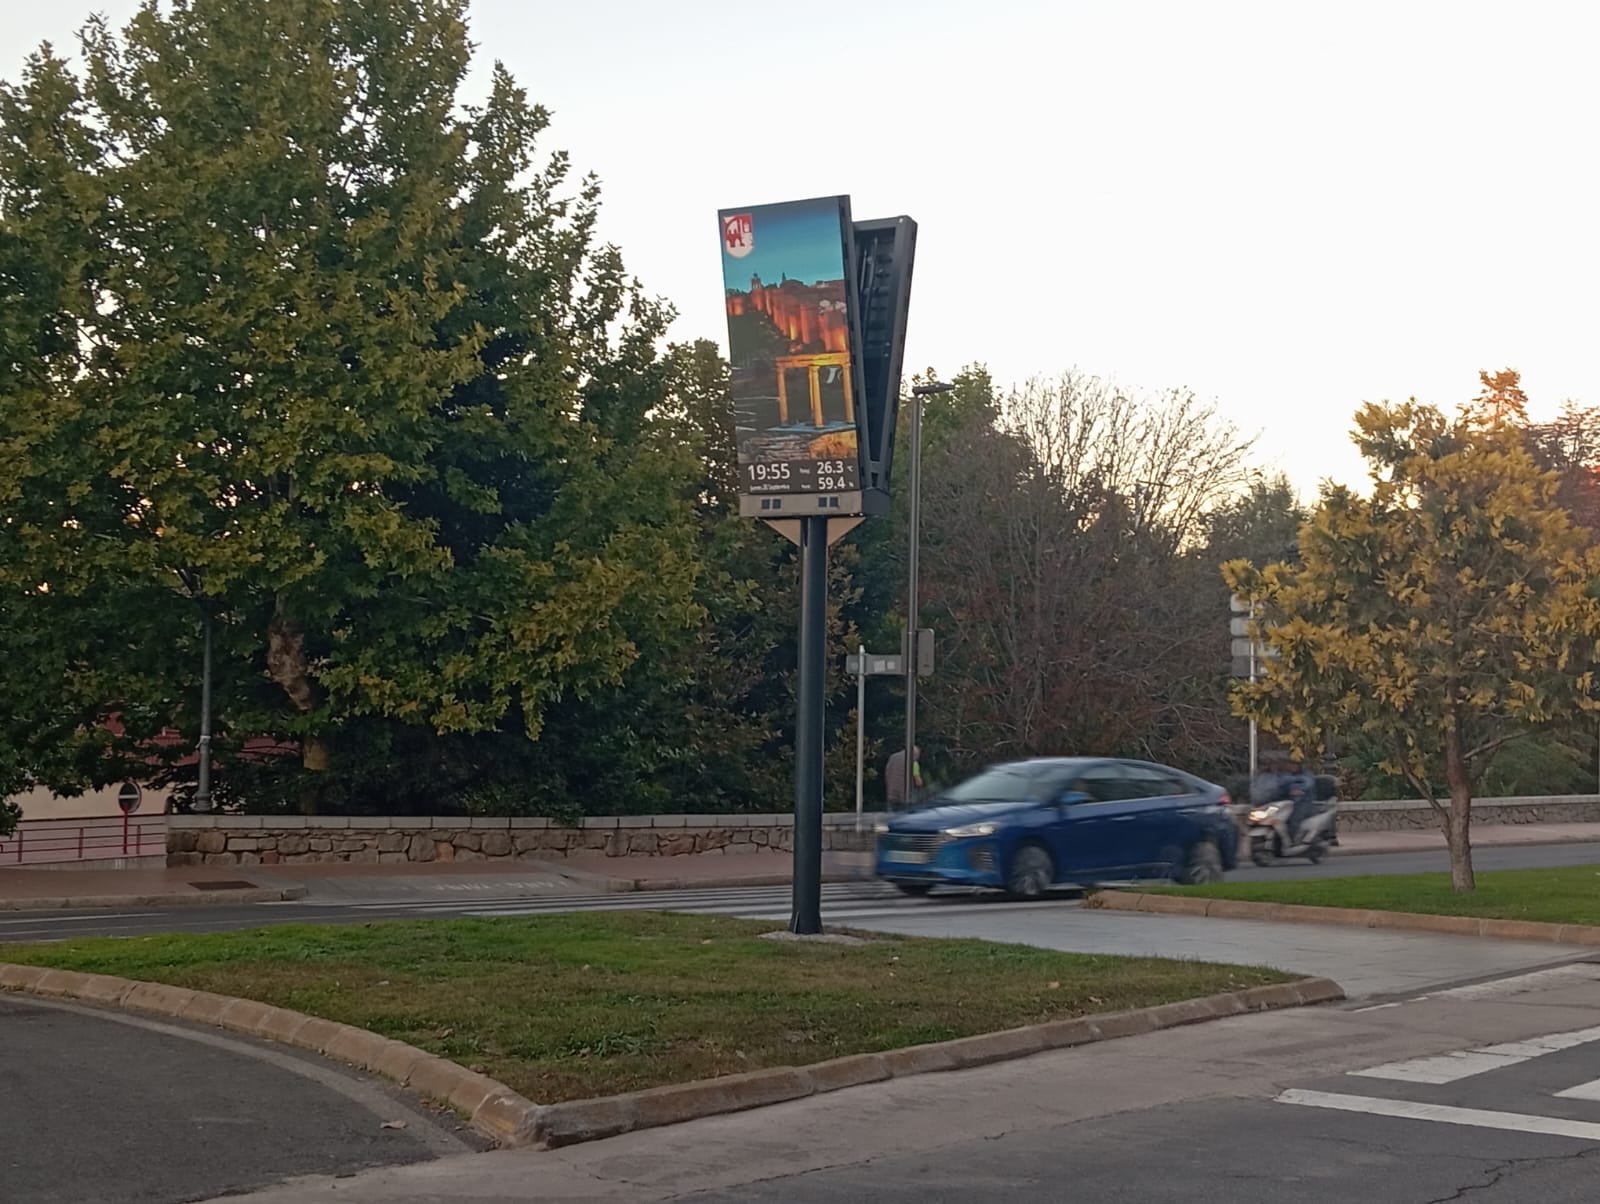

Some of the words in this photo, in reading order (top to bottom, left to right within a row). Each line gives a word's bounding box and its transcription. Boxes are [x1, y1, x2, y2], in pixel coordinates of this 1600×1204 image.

[748, 463, 790, 480] 19:55
[817, 461, 844, 474] 26.3
[818, 477, 846, 490] 59.4
